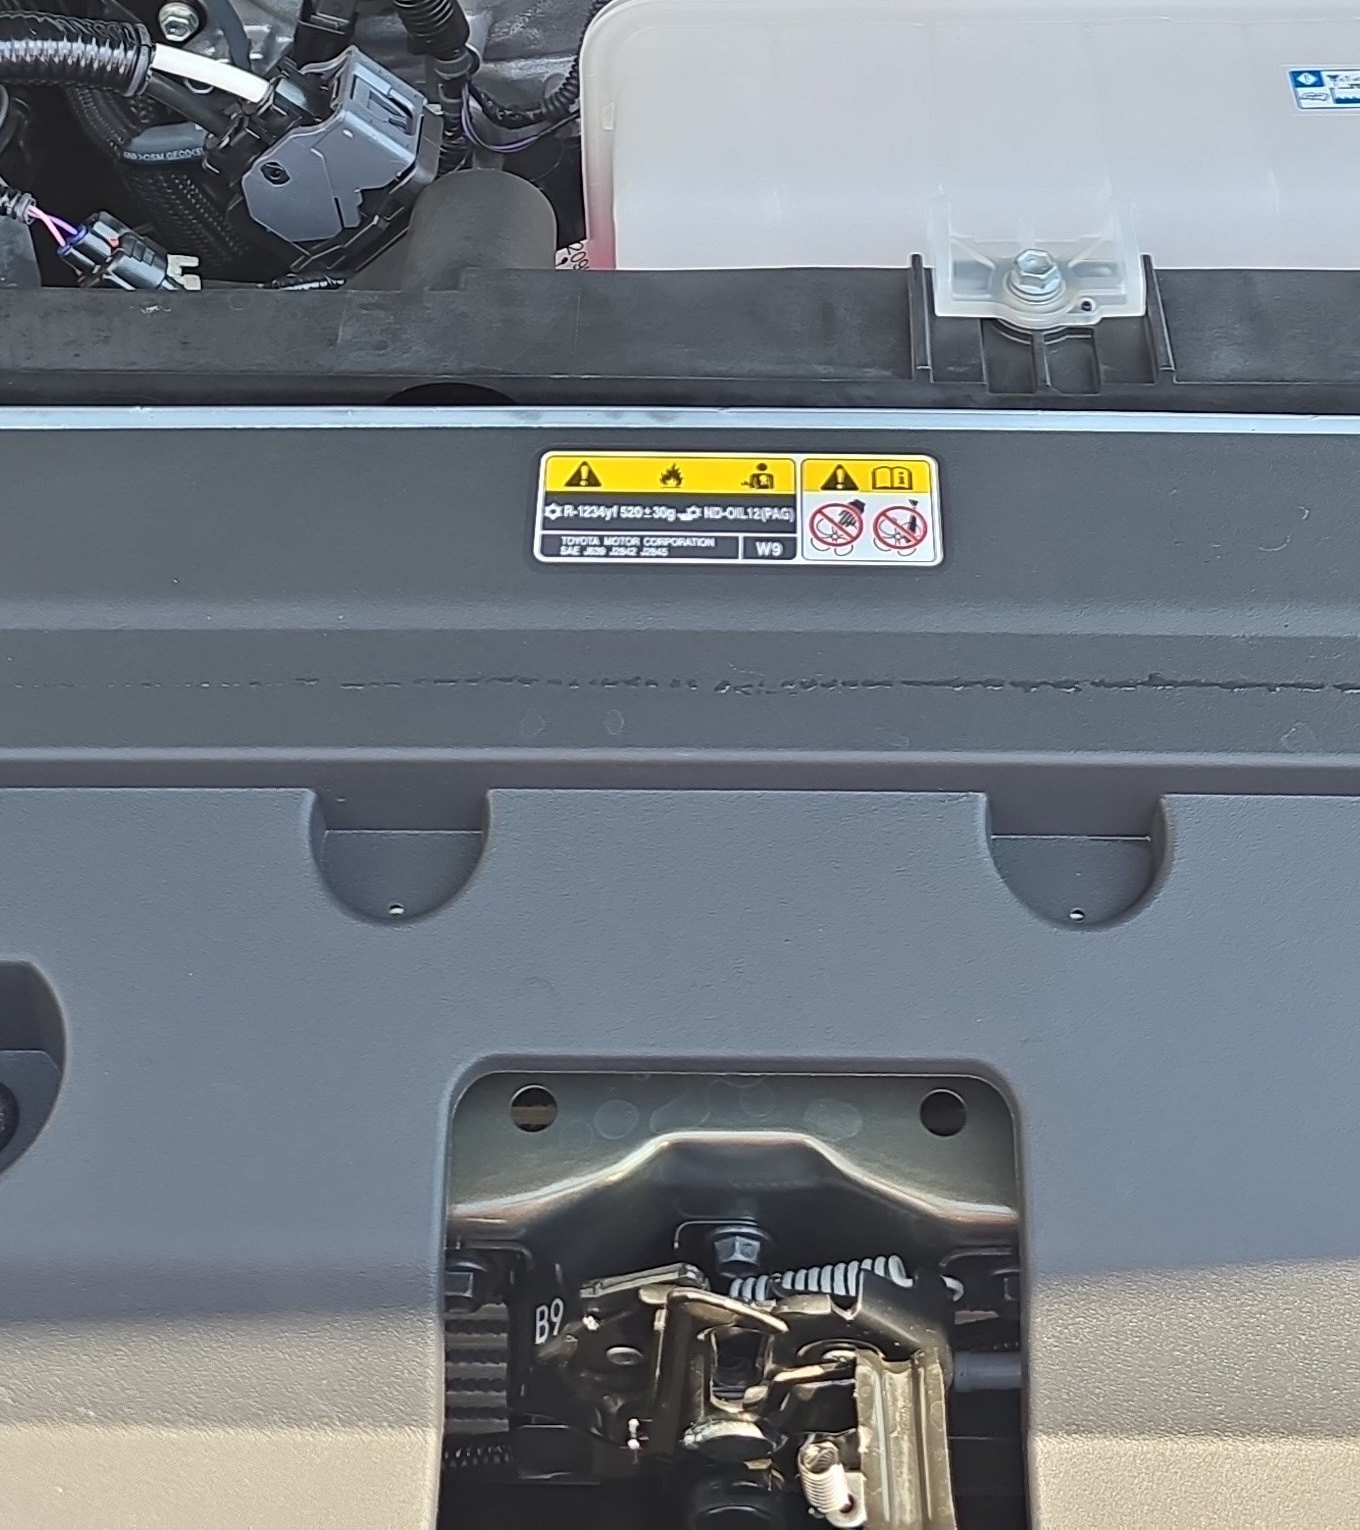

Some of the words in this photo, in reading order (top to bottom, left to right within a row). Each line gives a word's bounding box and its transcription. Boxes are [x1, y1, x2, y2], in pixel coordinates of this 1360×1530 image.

[560, 536, 600, 546] TOYOTA
[603, 537, 639, 547] MOTOR
[643, 537, 715, 548] CORPORATION
[756, 541, 783, 557] W9
[534, 1297, 564, 1345] B9
